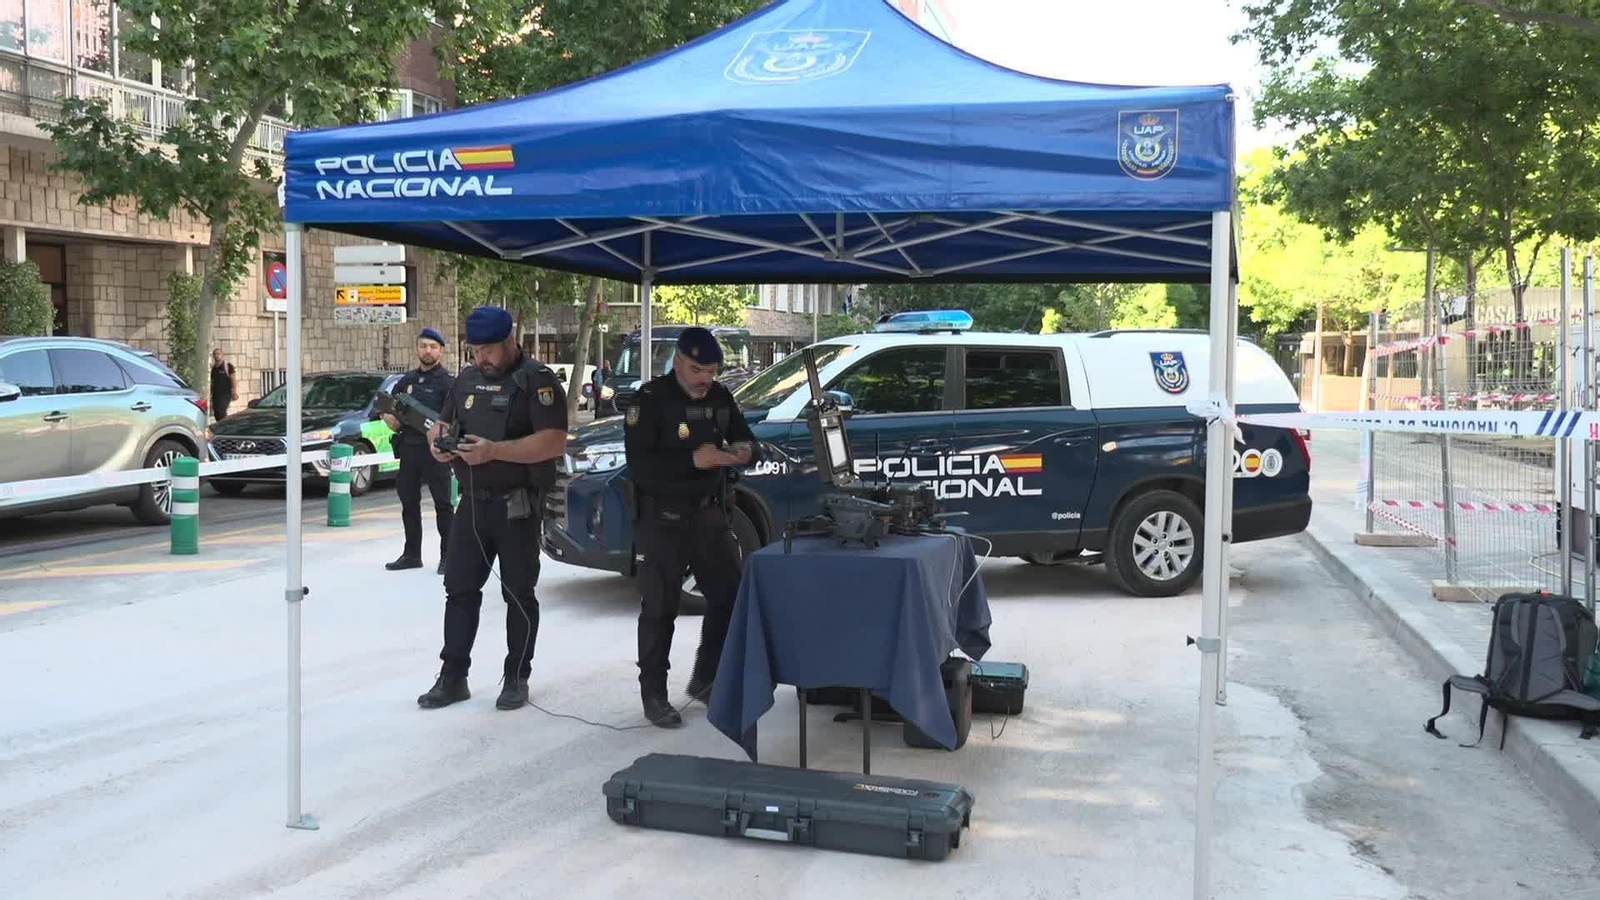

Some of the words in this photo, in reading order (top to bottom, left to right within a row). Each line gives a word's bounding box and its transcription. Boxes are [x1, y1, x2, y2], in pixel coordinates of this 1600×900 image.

[1134, 126, 1163, 134] UAP
[315, 148, 462, 175] POLICIA
[316, 175, 513, 200] NACIONAL
[853, 453, 1006, 478] POLICIA
[924, 476, 1042, 500] IONAL
[1051, 511, 1081, 521] @policia
